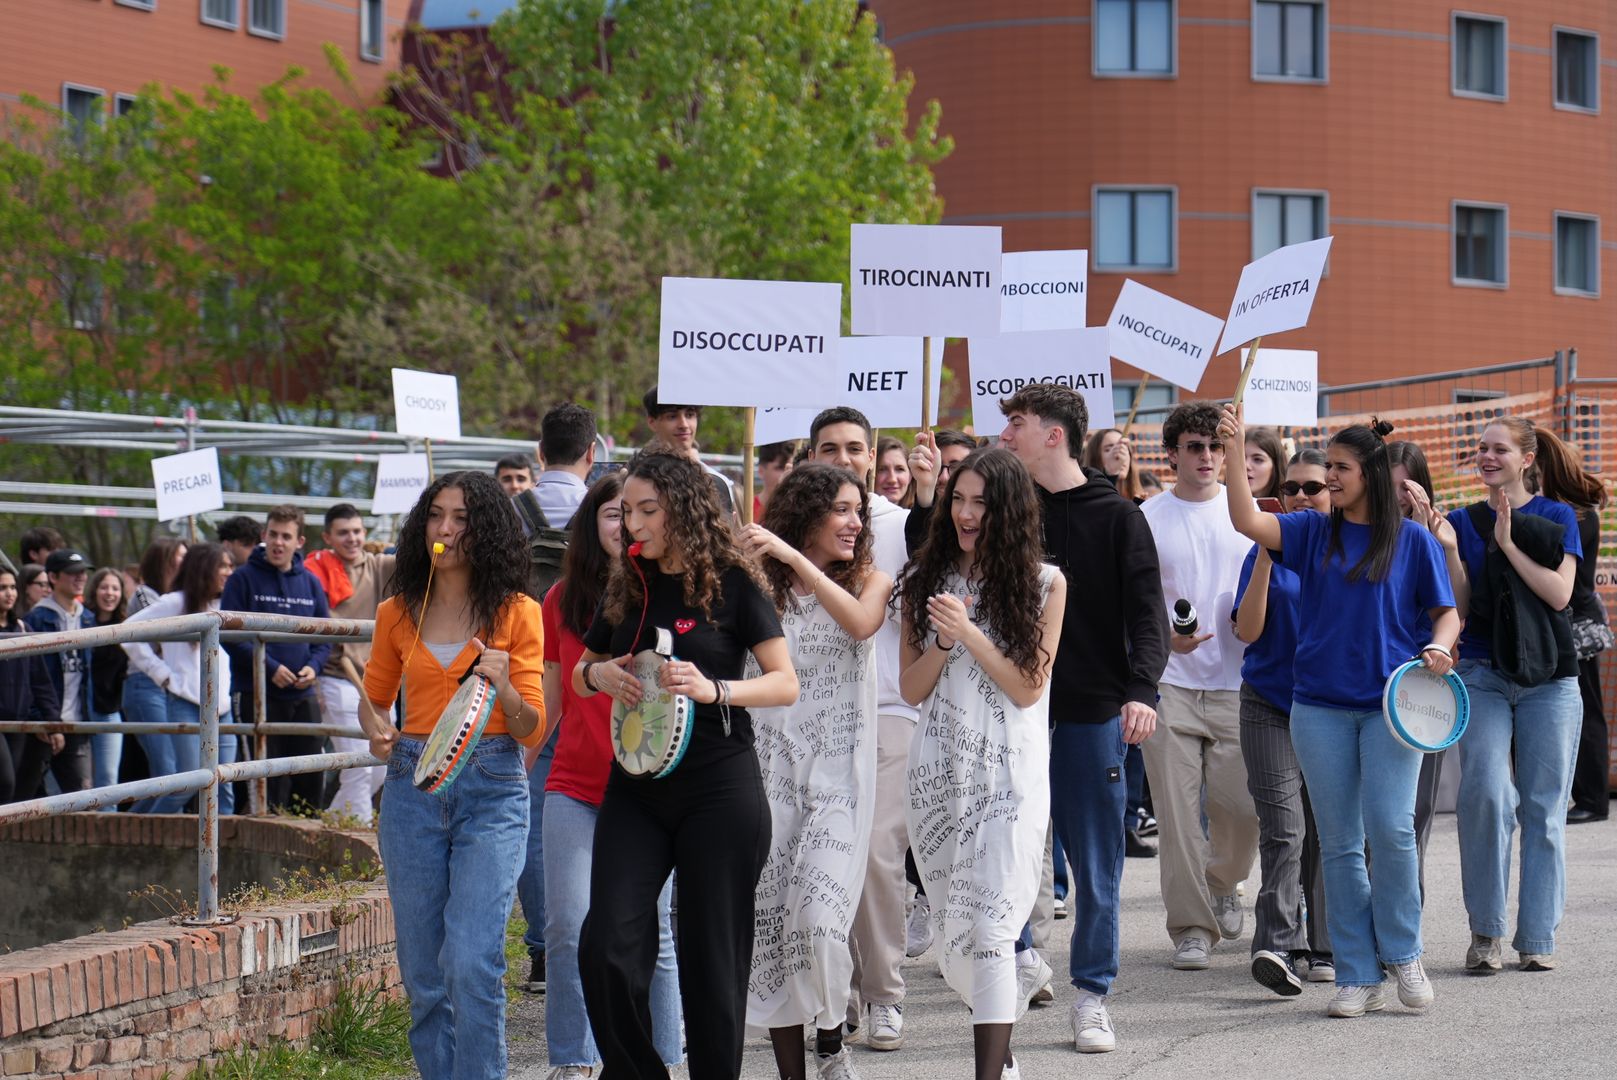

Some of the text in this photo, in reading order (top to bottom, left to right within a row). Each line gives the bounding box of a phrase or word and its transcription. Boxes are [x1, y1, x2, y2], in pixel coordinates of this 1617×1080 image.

[859, 268, 991, 289] TIROCINANTI
[1235, 278, 1310, 318] IN OFFERTA
[672, 329, 825, 355] DISOCCUPATI
[1118, 313, 1203, 359] INOCCUPATI
[847, 370, 909, 392] NEET
[1250, 378, 1312, 392] SCHIZZINOSI
[405, 394, 448, 412] CHOOSY
[162, 473, 213, 495] PRECARI
[798, 632, 849, 649] NON SONO
[798, 644, 846, 661] PERFETTE
[817, 676, 838, 688] CON
[949, 879, 973, 891] NON
